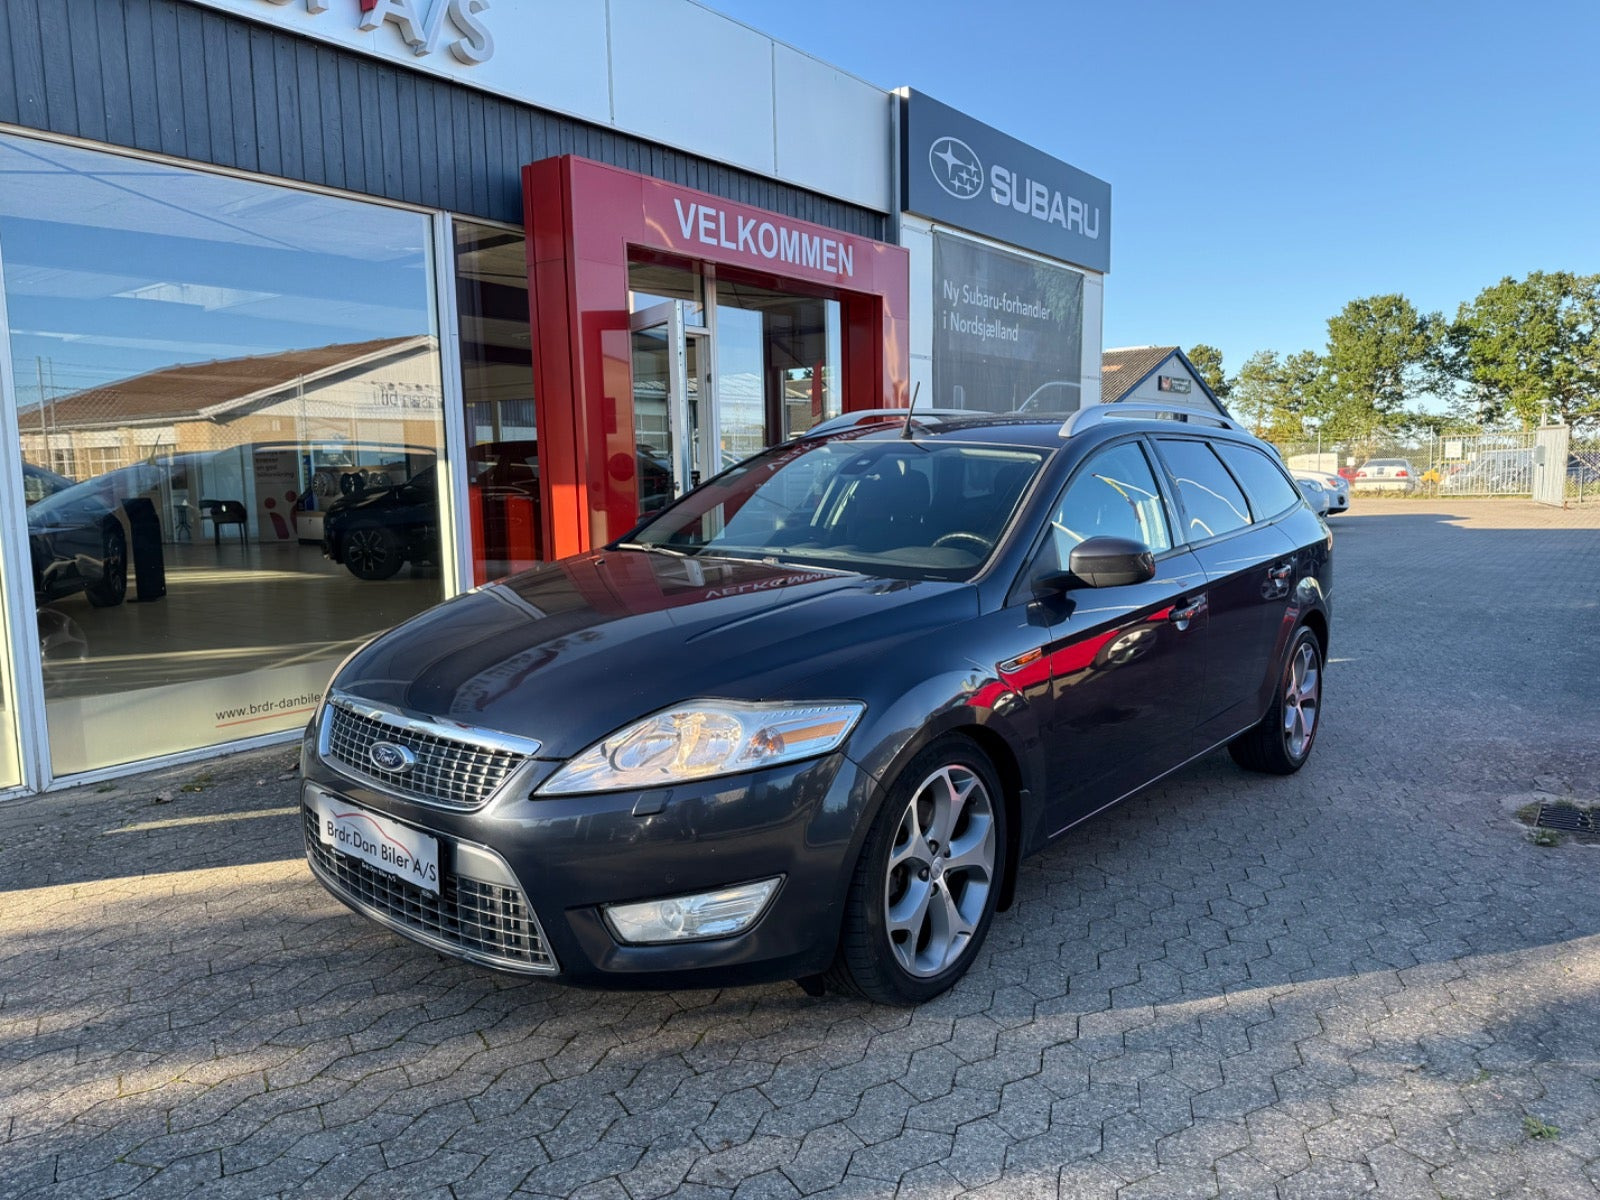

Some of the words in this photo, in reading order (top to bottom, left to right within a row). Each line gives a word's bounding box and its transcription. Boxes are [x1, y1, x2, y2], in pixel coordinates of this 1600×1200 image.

[990, 164, 1100, 240] SUBARU
[673, 198, 854, 277] VELKOMMEN
[943, 278, 960, 307] Ny
[962, 284, 1052, 320] Subaru-forhandler
[943, 310, 947, 329] i
[950, 311, 1019, 341] Nordsjælland
[215, 692, 324, 721] www.brdr-danbile
[375, 747, 397, 765] Ford
[326, 820, 377, 857] Brdr.Dan
[381, 844, 409, 869] Biler
[412, 858, 437, 882] A/S
